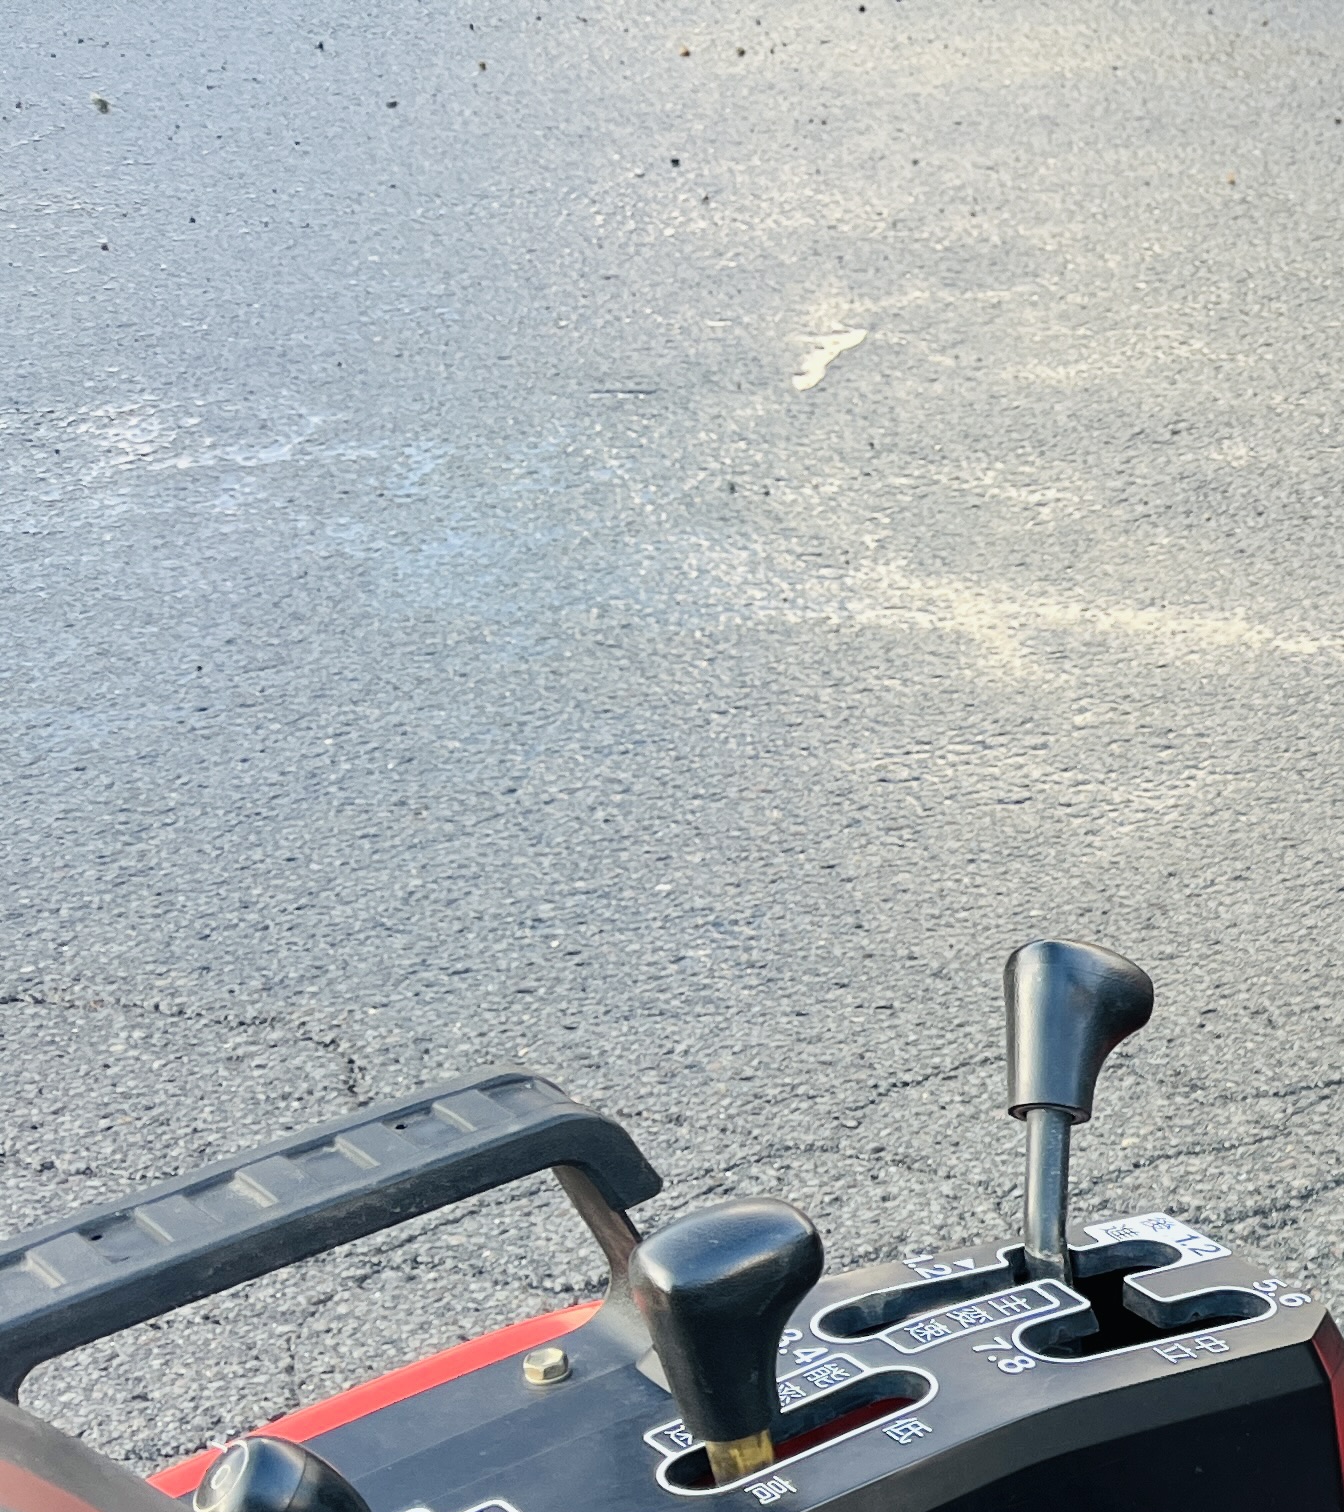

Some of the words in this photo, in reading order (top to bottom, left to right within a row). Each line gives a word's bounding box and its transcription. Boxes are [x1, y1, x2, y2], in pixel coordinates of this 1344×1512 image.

[1174, 1232, 1224, 1258] 1.2
[902, 1253, 953, 1280] 1.2
[1251, 1277, 1312, 1308] 5.6
[904, 1293, 1029, 1345] 主変速
[972, 1335, 1037, 1376] 7.8
[1153, 1334, 1232, 1365] 中立
[882, 1416, 933, 1445] 低
[743, 1475, 798, 1506] 高
